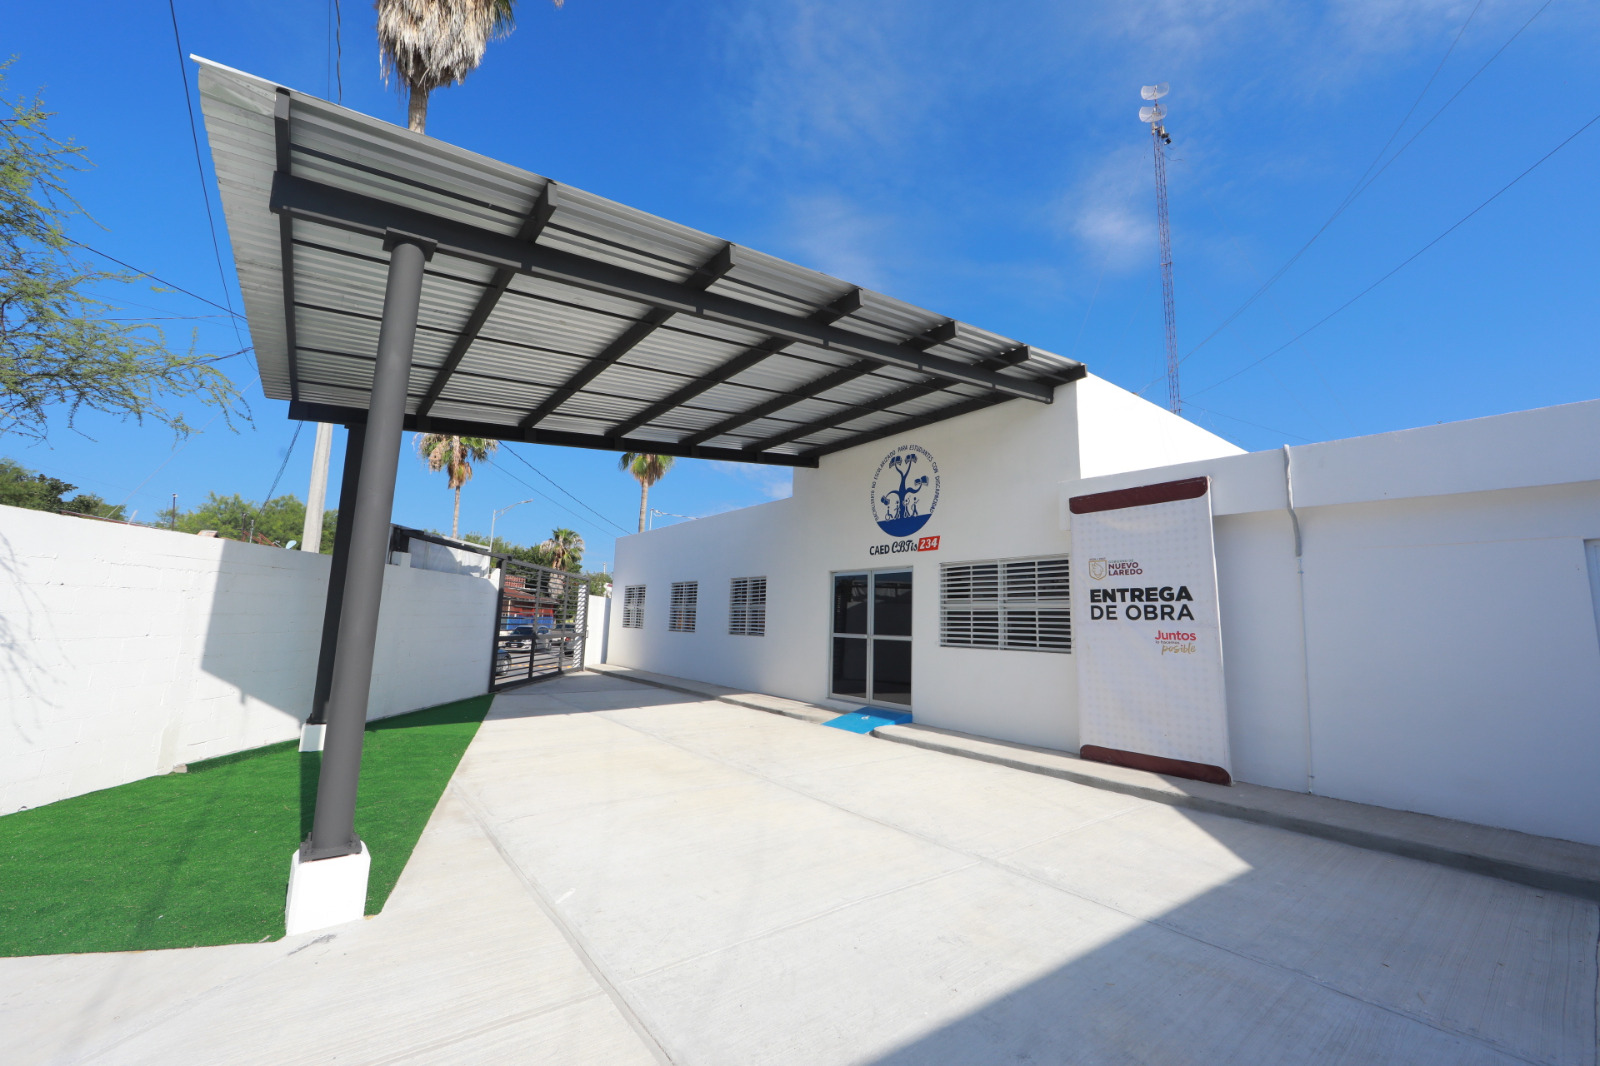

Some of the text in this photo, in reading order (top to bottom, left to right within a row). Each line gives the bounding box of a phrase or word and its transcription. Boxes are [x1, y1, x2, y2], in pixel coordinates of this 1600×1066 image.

[897, 444, 908, 452] PARA
[909, 444, 933, 462] ESTUDIANTES
[931, 461, 939, 474] CON
[869, 538, 938, 555] CAED CBTis 234
[1108, 561, 1139, 569] NUEVO
[1108, 568, 1143, 576] LAREDO
[1090, 586, 1193, 603] ENTREGA
[1090, 604, 1195, 620] DE OBRA
[1154, 630, 1197, 641] Juntos
[1161, 642, 1197, 655] posible
